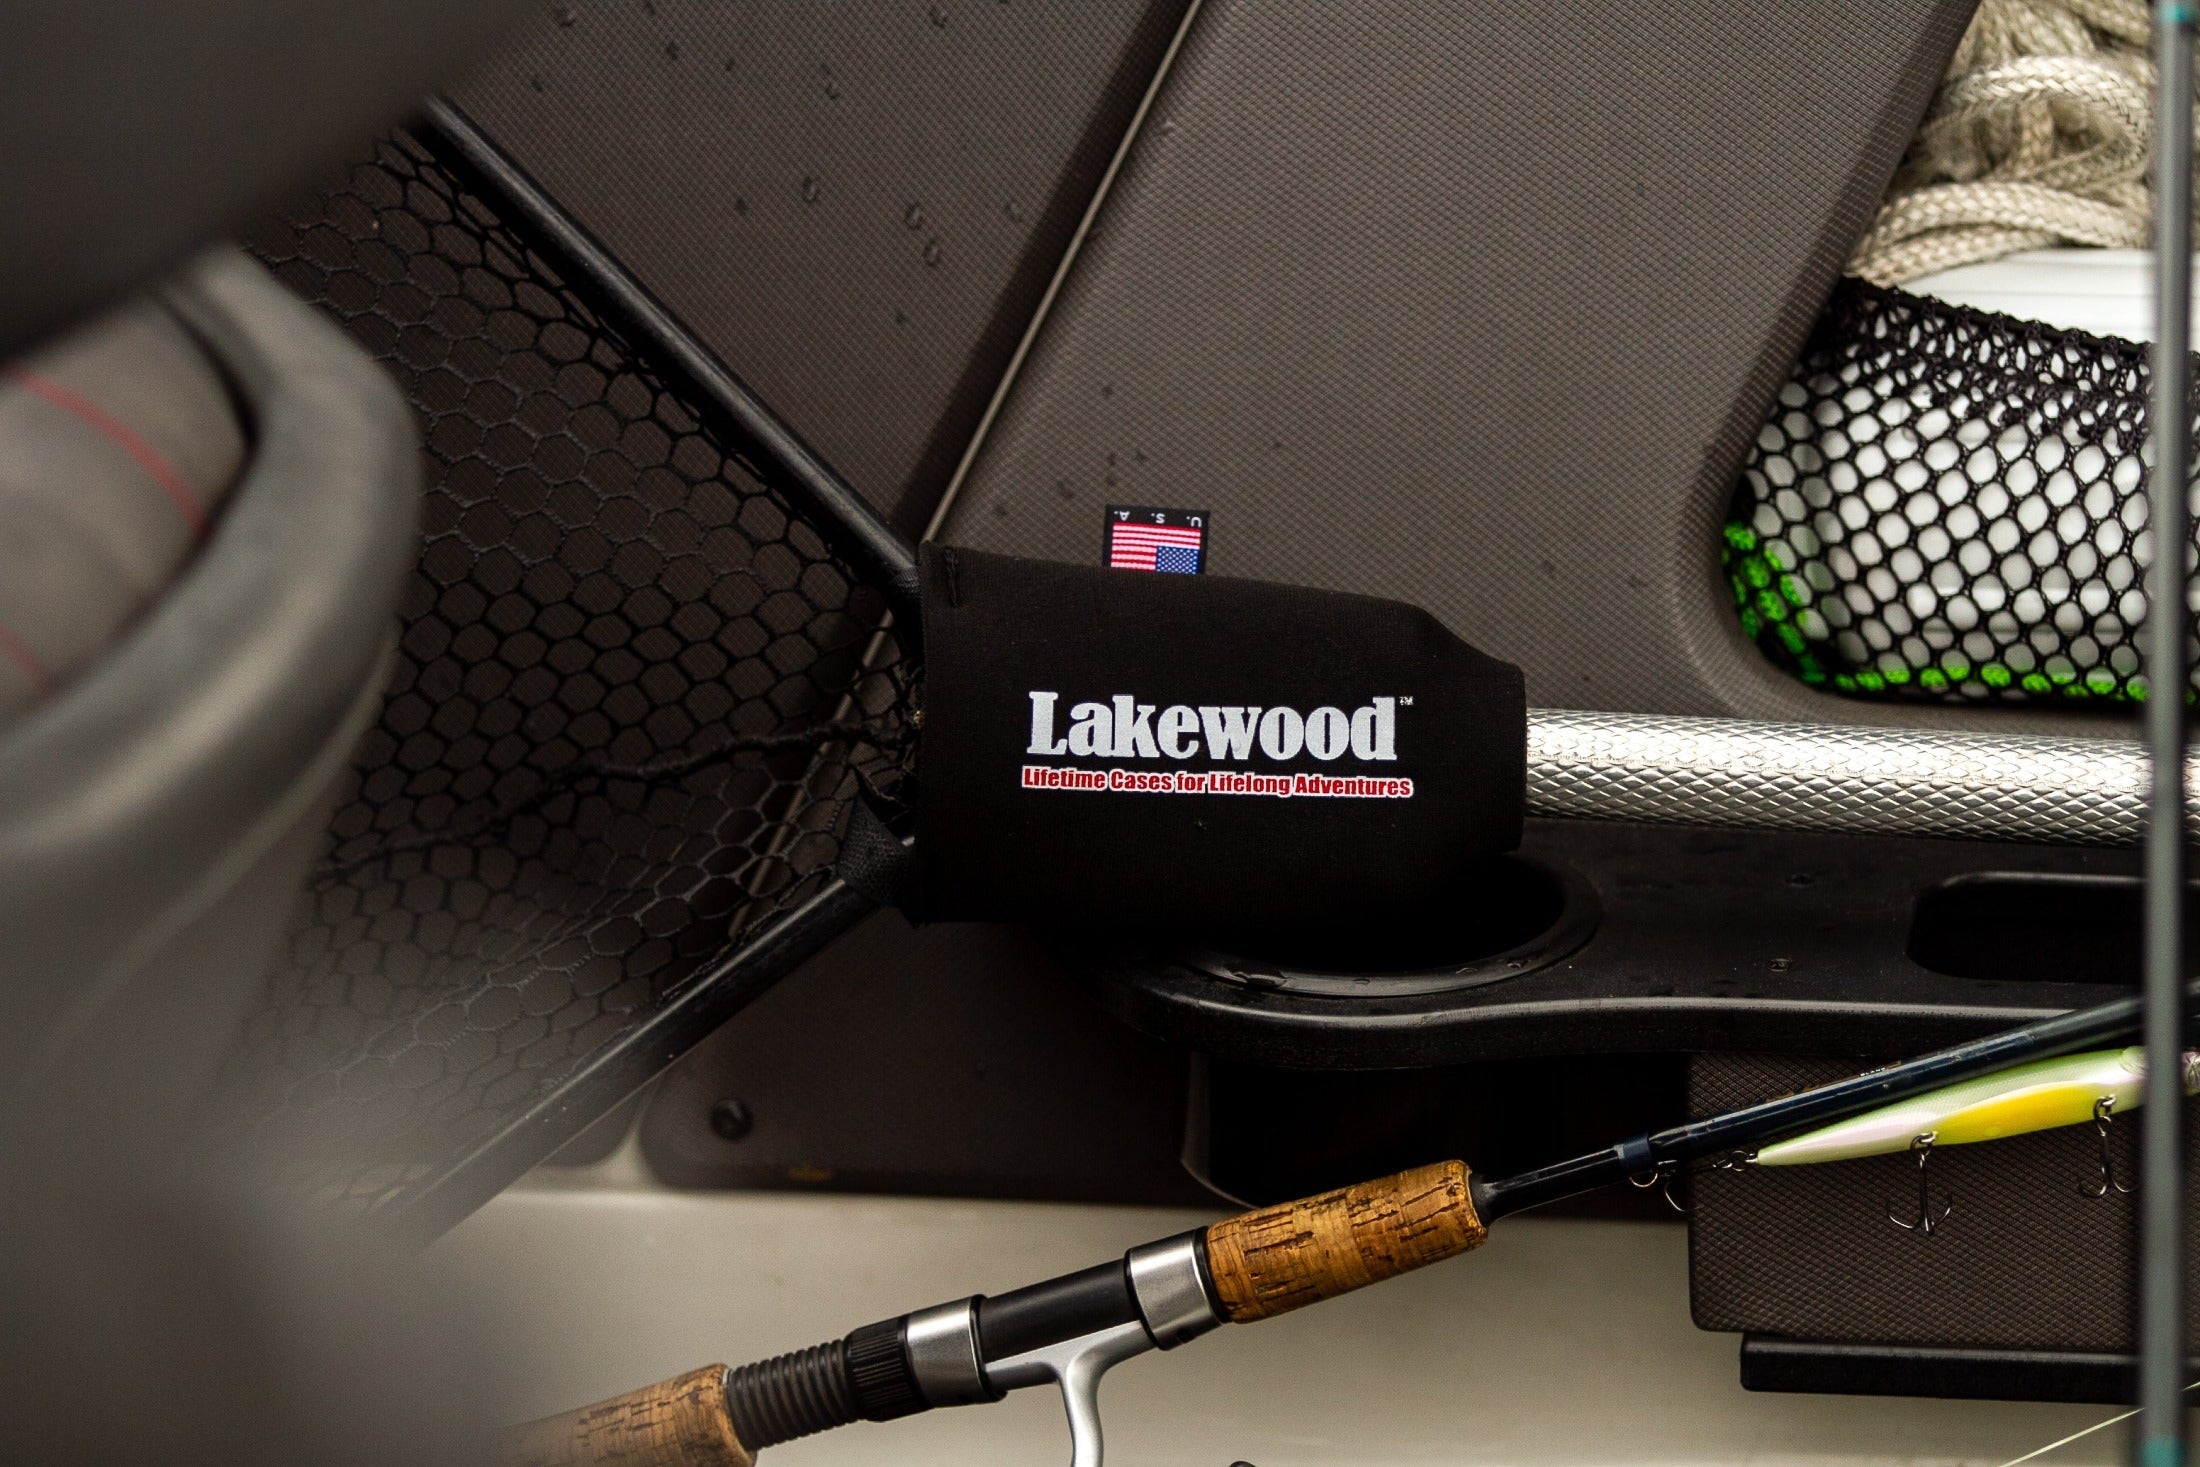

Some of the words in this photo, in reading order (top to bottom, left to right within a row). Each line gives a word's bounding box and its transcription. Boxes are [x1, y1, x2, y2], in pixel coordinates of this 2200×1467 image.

[1027, 691, 1397, 761] Lakewood
[1022, 766, 1107, 790] Lifetime
[1109, 769, 1174, 793] Cases
[1175, 771, 1208, 794] for
[1208, 772, 1293, 797] Lifelong
[1294, 774, 1414, 798] Adventures
